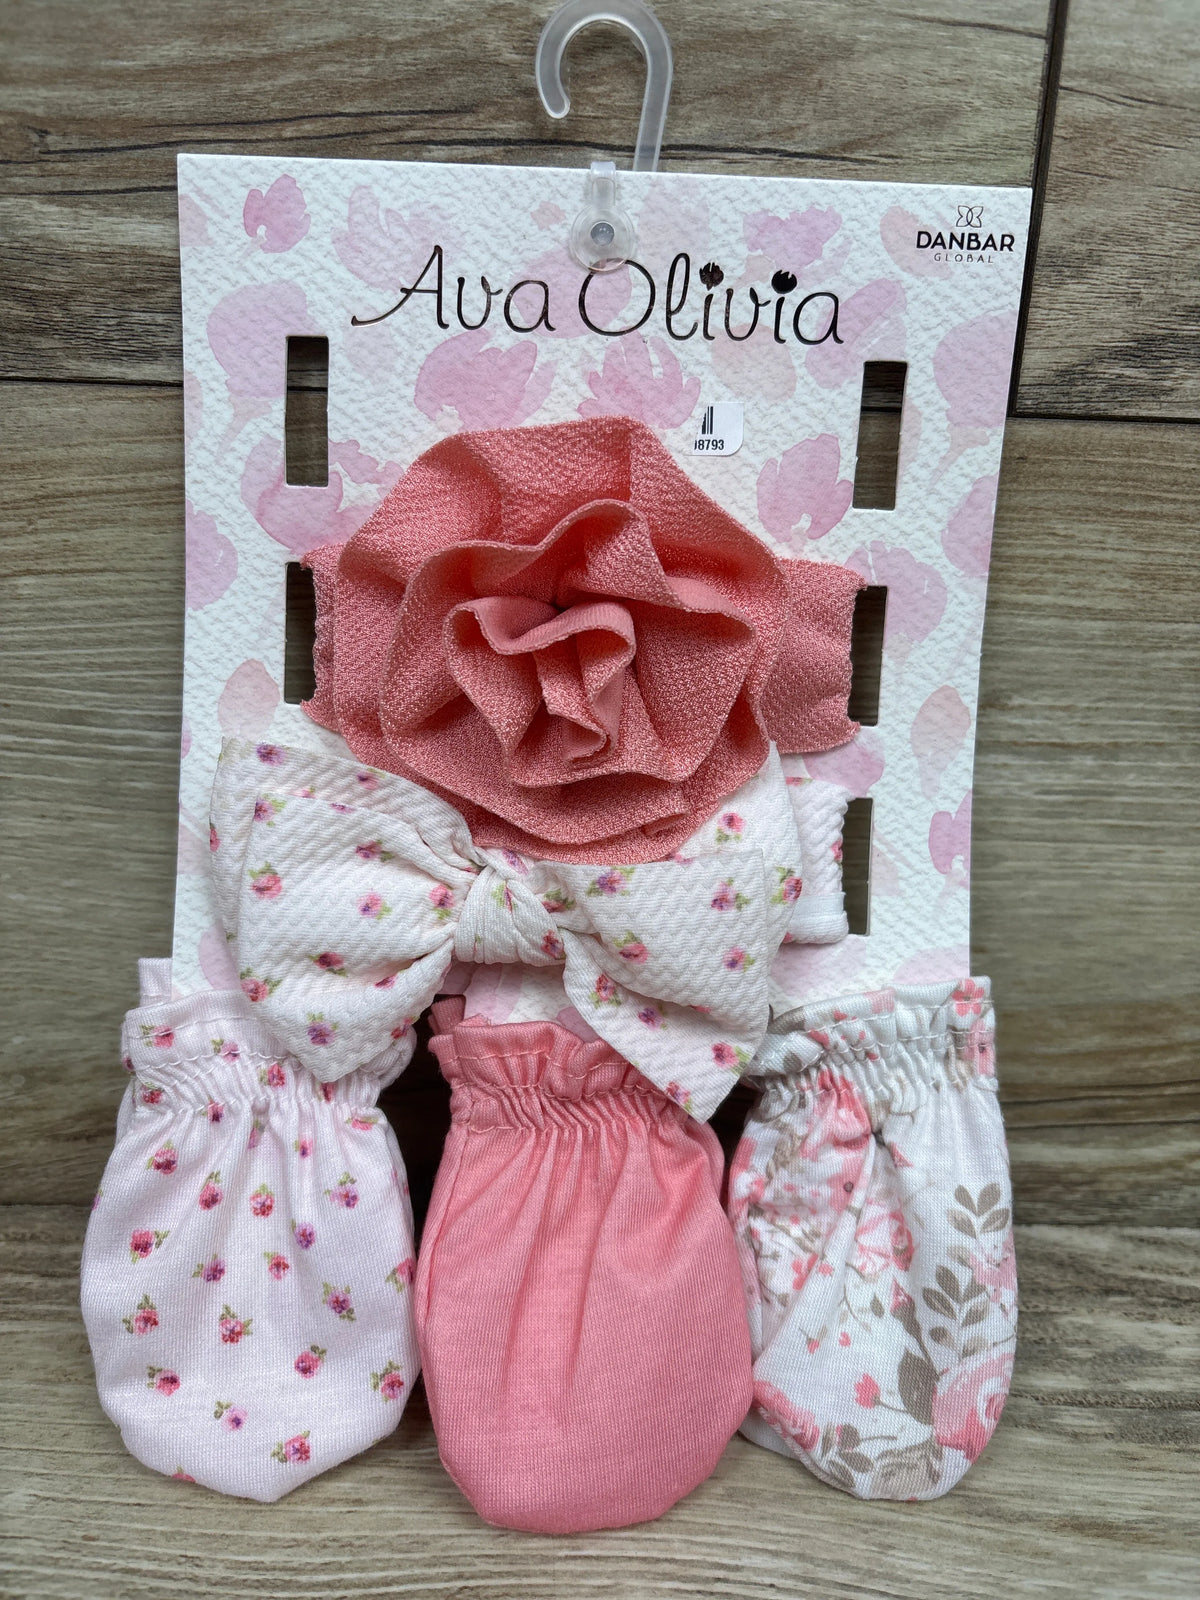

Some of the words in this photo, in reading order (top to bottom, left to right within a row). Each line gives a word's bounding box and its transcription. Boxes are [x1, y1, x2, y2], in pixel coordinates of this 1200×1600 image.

[916, 231, 1015, 252] DANBAR
[933, 252, 994, 264] GLOBAL
[352, 245, 556, 332] Ava
[578, 252, 844, 345] Olivia
